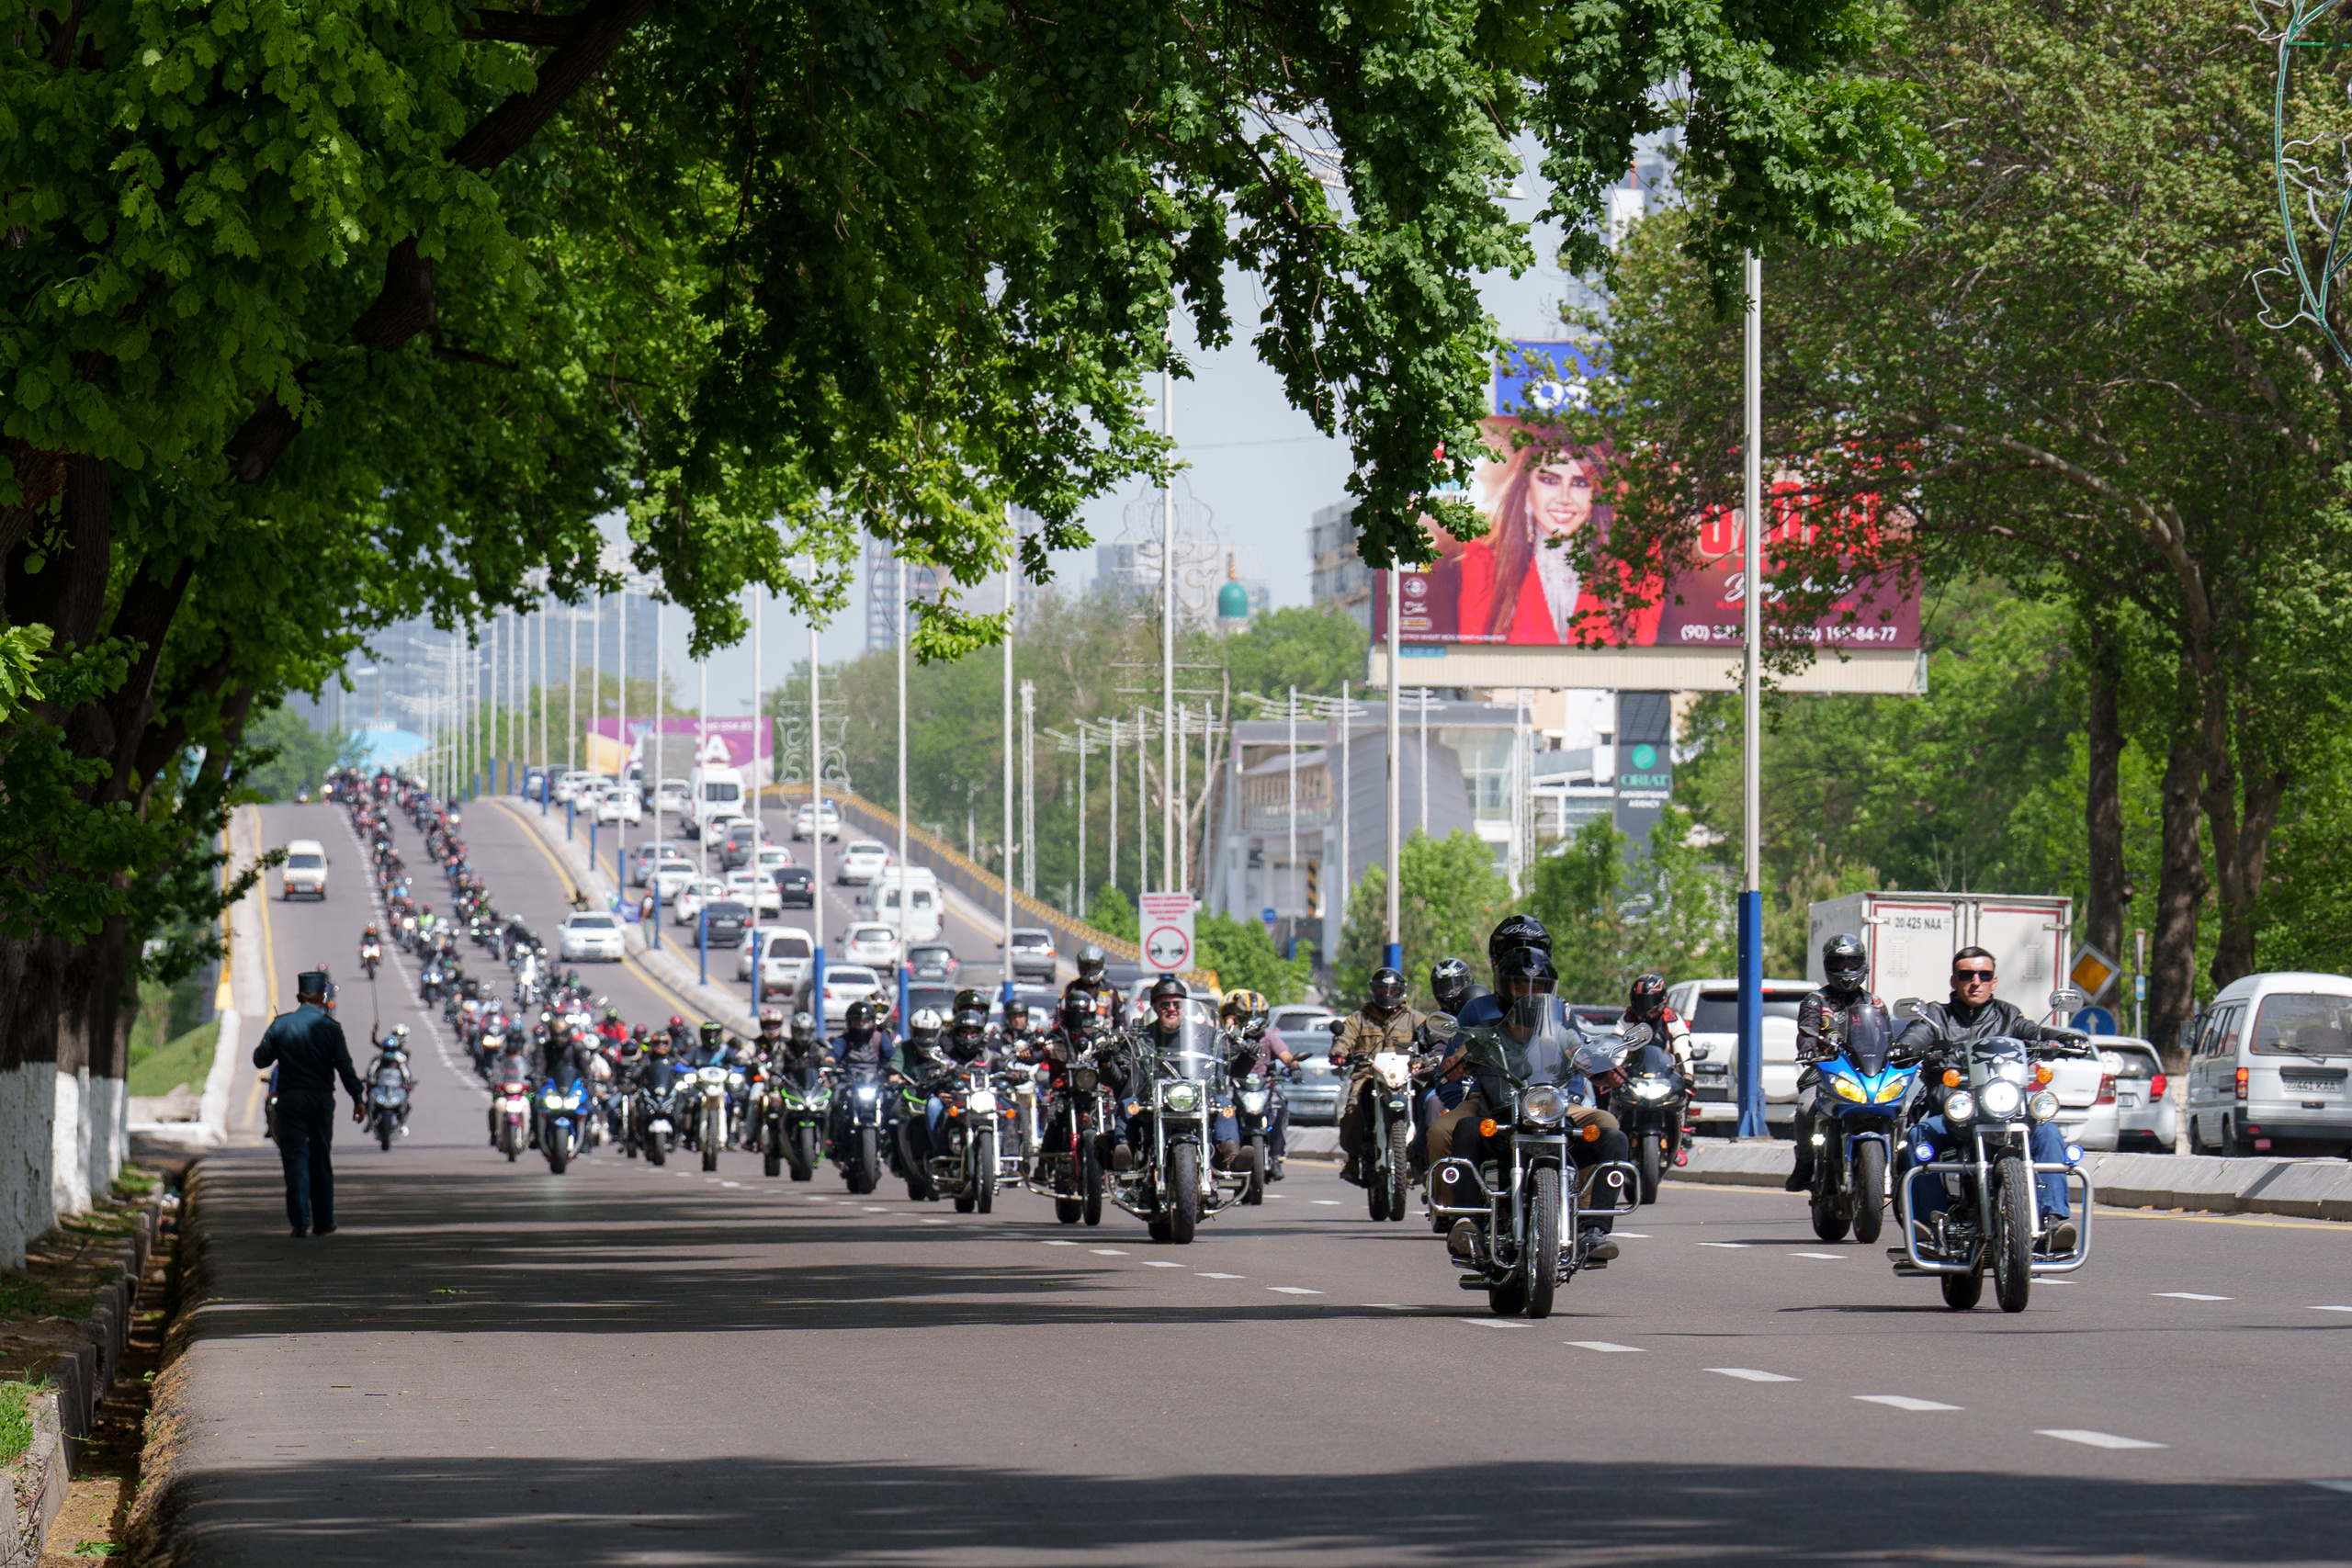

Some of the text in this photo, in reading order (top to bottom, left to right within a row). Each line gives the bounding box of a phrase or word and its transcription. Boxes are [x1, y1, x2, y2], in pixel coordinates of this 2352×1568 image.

[1680, 624, 1711, 642] (90)
[1906, 917, 1921, 929] 425
[1924, 918, 1941, 930] NAA
